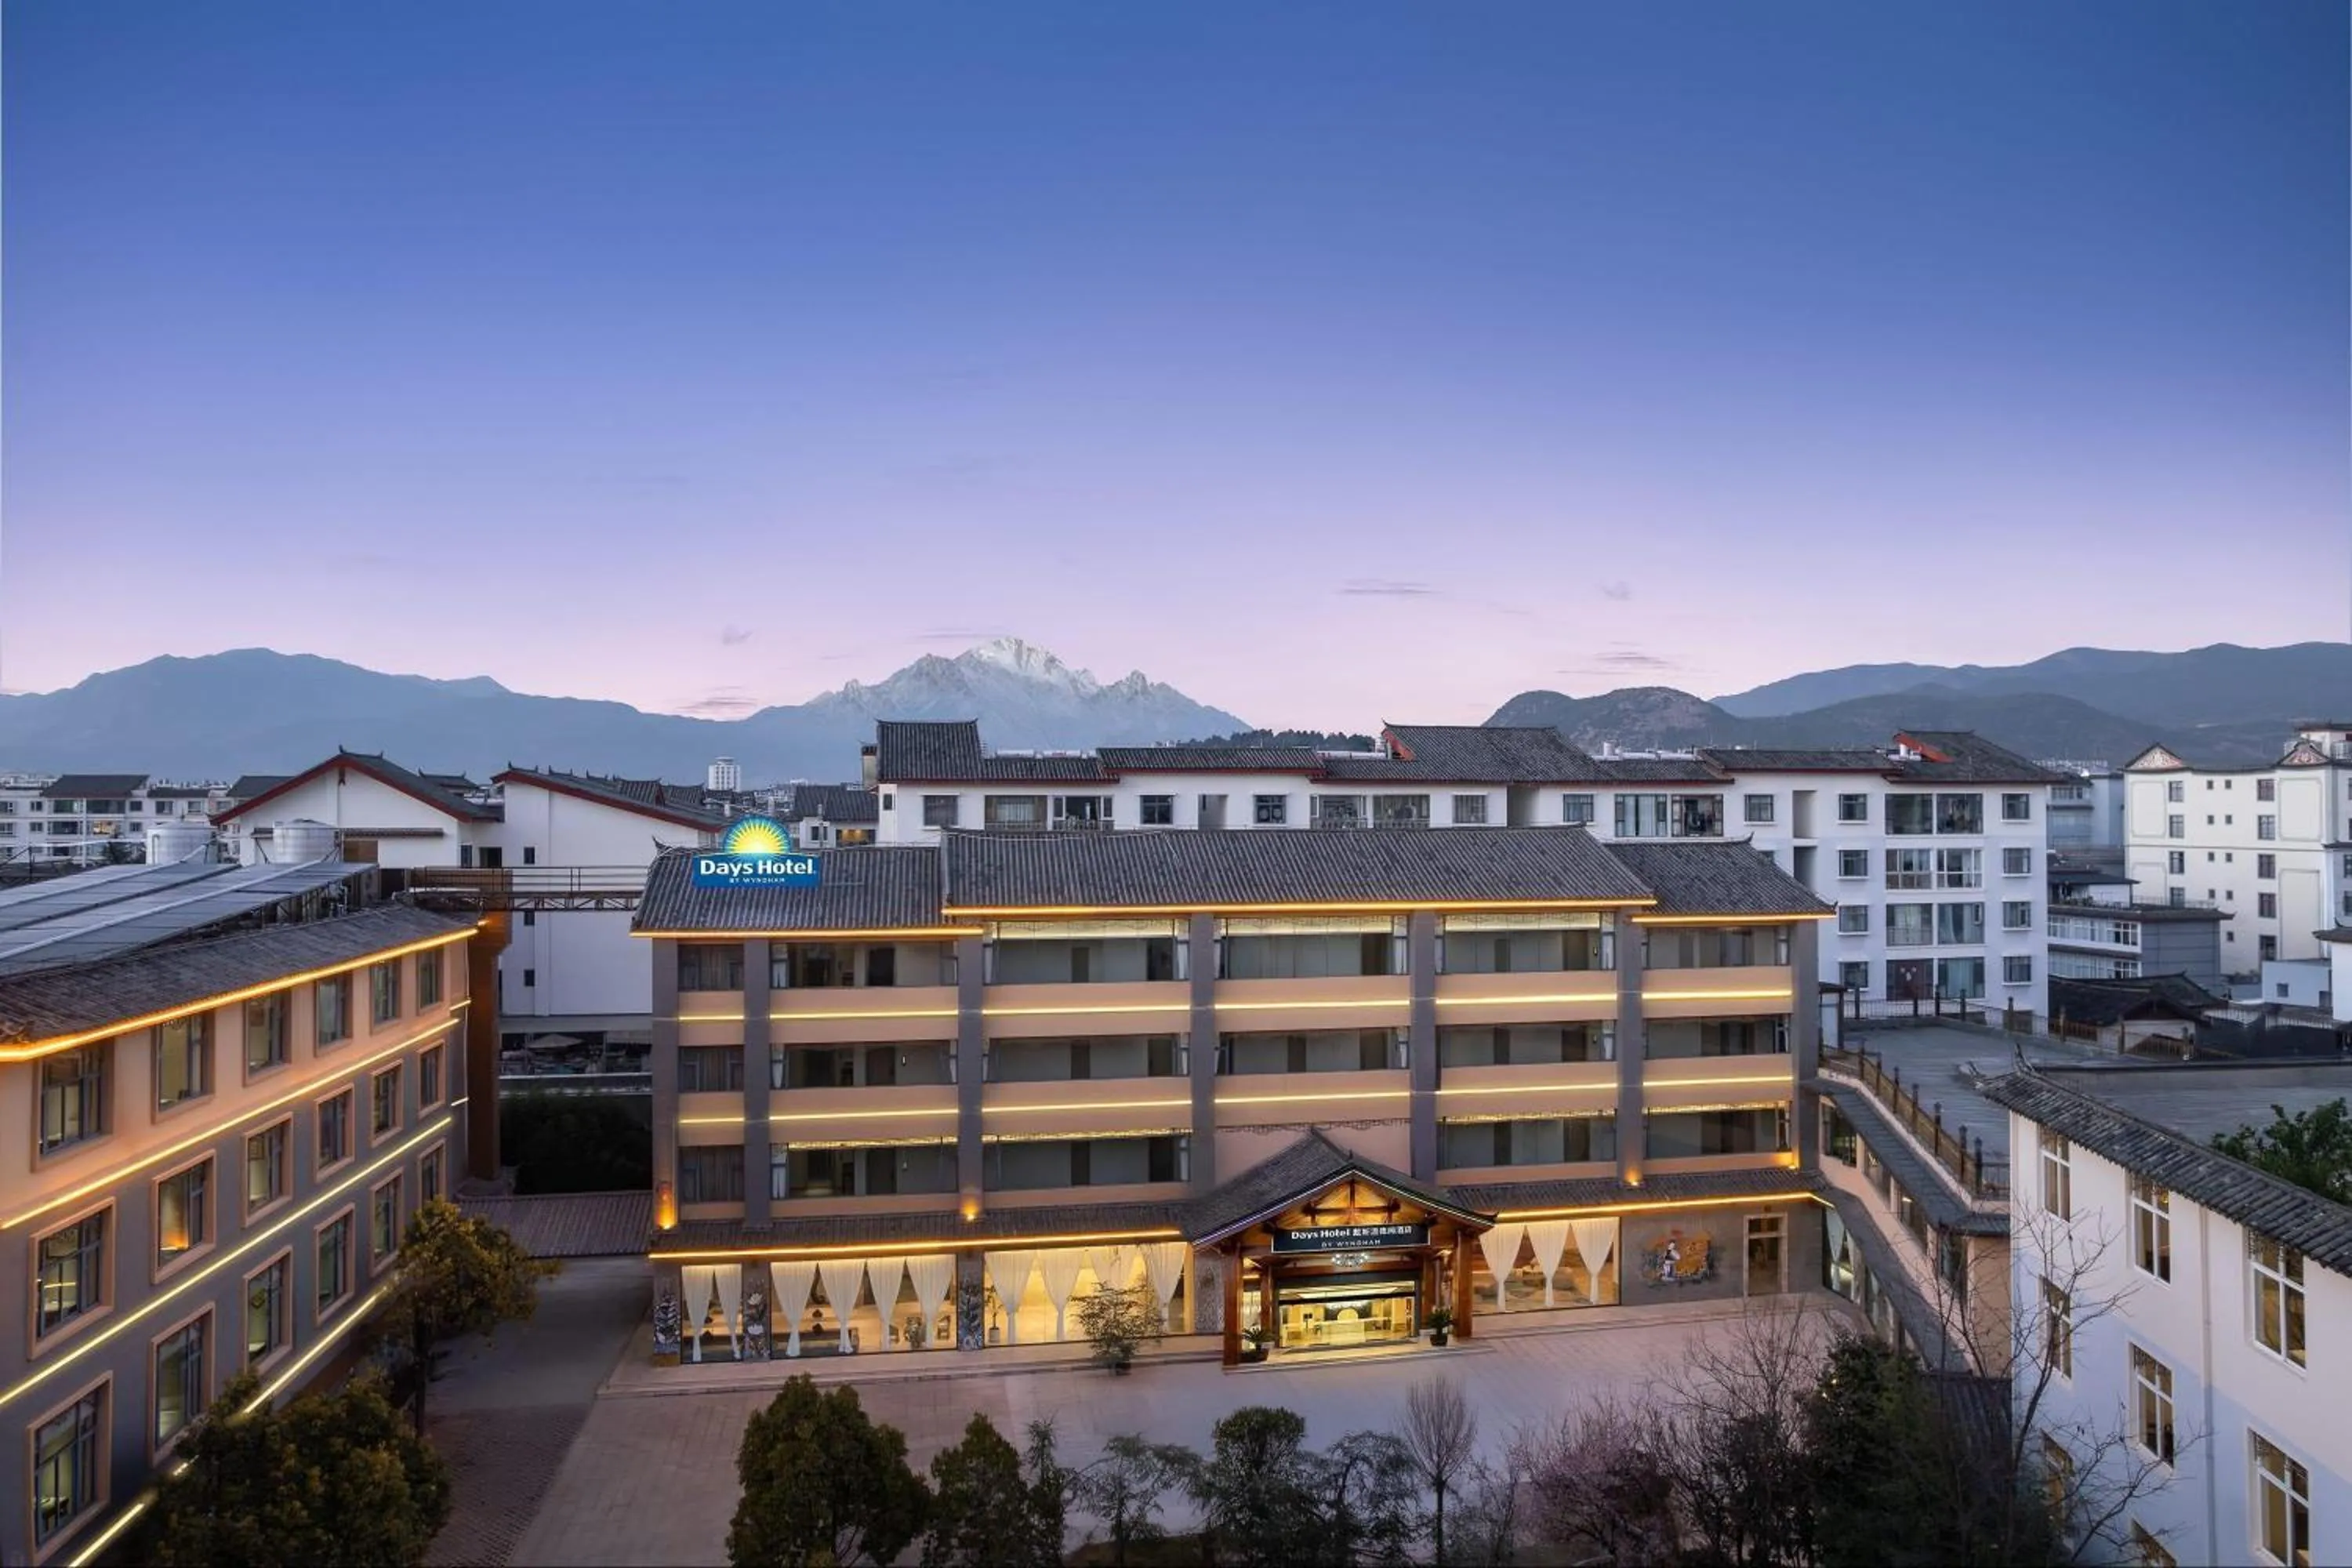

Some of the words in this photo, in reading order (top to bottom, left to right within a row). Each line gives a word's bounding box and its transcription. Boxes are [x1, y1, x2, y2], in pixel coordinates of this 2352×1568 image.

[700, 859, 753, 877] Days
[757, 858, 813, 874] Hotel
[1291, 1231, 1318, 1240] Days
[1320, 1229, 1349, 1238] Hotel
